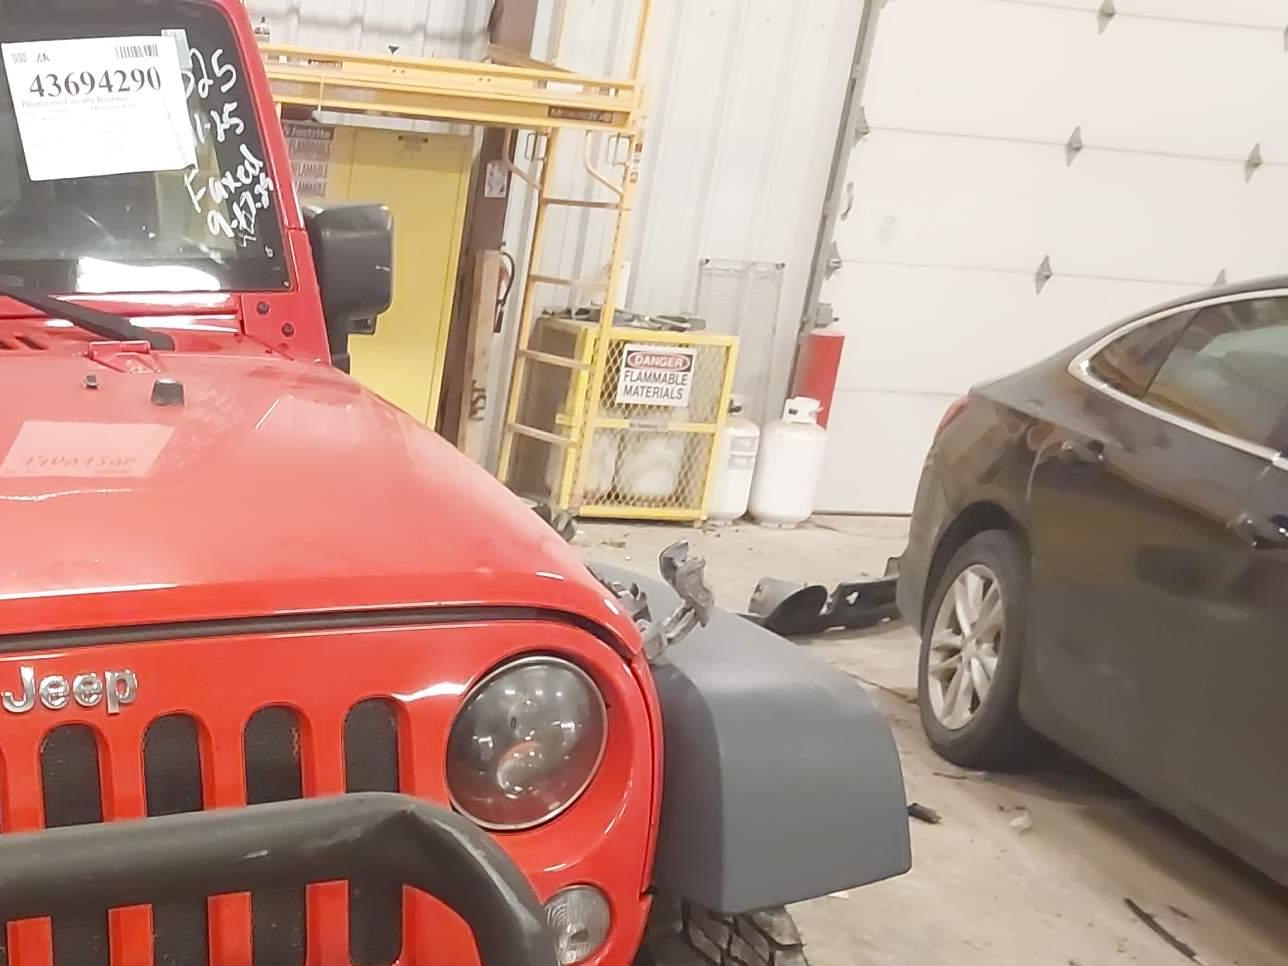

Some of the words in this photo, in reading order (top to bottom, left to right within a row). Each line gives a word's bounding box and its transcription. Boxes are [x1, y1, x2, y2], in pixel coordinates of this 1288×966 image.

[29, 66, 162, 98] 43694290
[634, 355, 684, 369] DANGER
[623, 370, 689, 386] FLAMMABLE
[623, 385, 683, 400] MATERIALS
[1, 665, 138, 715] Jeep
